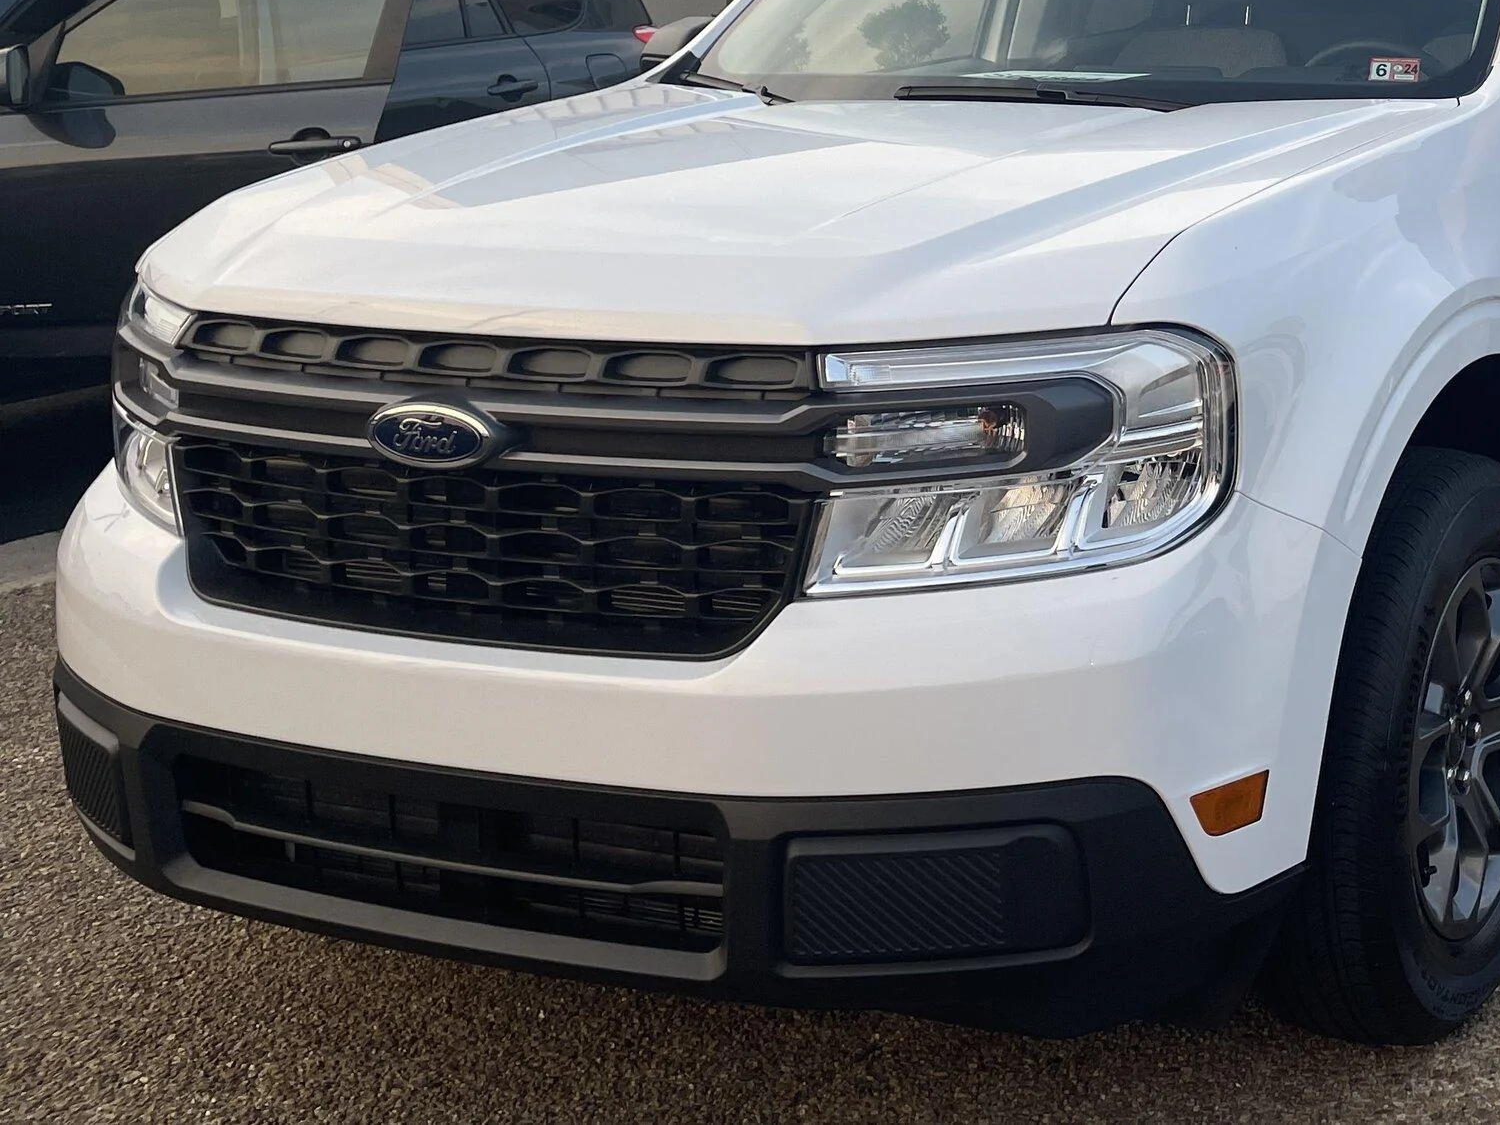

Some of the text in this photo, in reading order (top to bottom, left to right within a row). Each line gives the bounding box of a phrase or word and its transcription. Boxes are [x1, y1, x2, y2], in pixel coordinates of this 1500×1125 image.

[1376, 64, 1418, 77] 6 24
[0, 303, 53, 315] PORT
[393, 417, 458, 455] Ford
